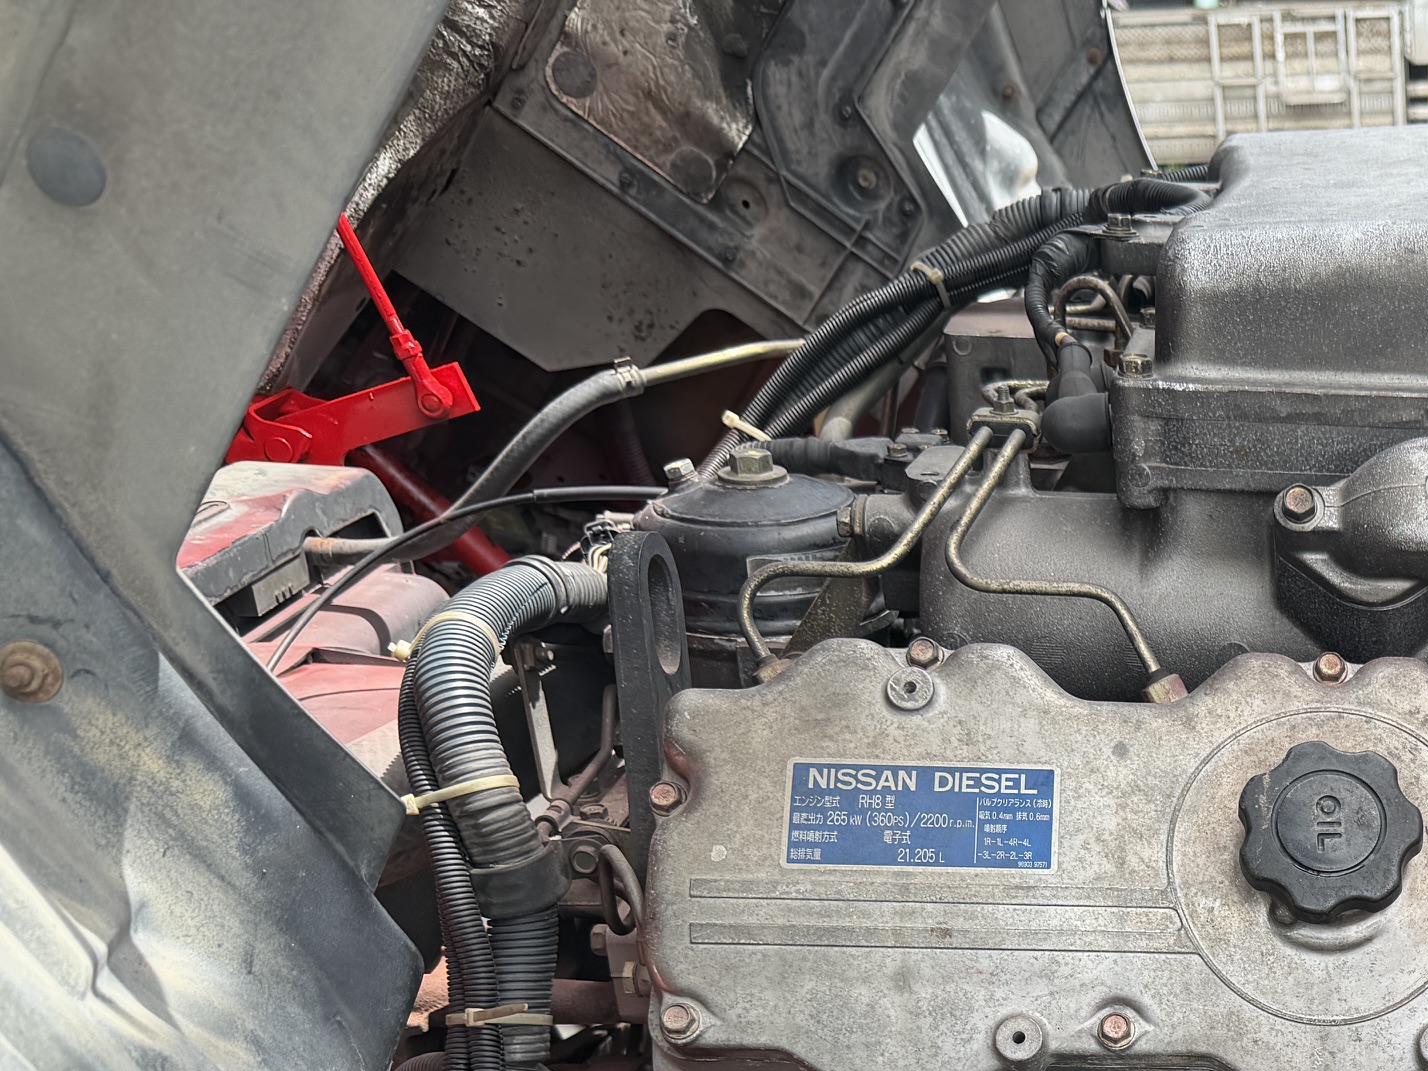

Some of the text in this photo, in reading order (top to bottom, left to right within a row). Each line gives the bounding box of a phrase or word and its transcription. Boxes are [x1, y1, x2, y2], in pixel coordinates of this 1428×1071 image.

[808, 768, 1038, 794] NISSAN DIESEL
[794, 795, 840, 808] エンジン型式
[858, 794, 882, 809] RH8
[792, 812, 824, 825] 最高出力
[827, 812, 849, 826] 265
[850, 814, 863, 826] kW
[1315, 794, 1343, 854] OIL
[790, 830, 911, 845] 燃料噴射方式 電子式
[789, 848, 945, 863] 総排気量 21.205 L
